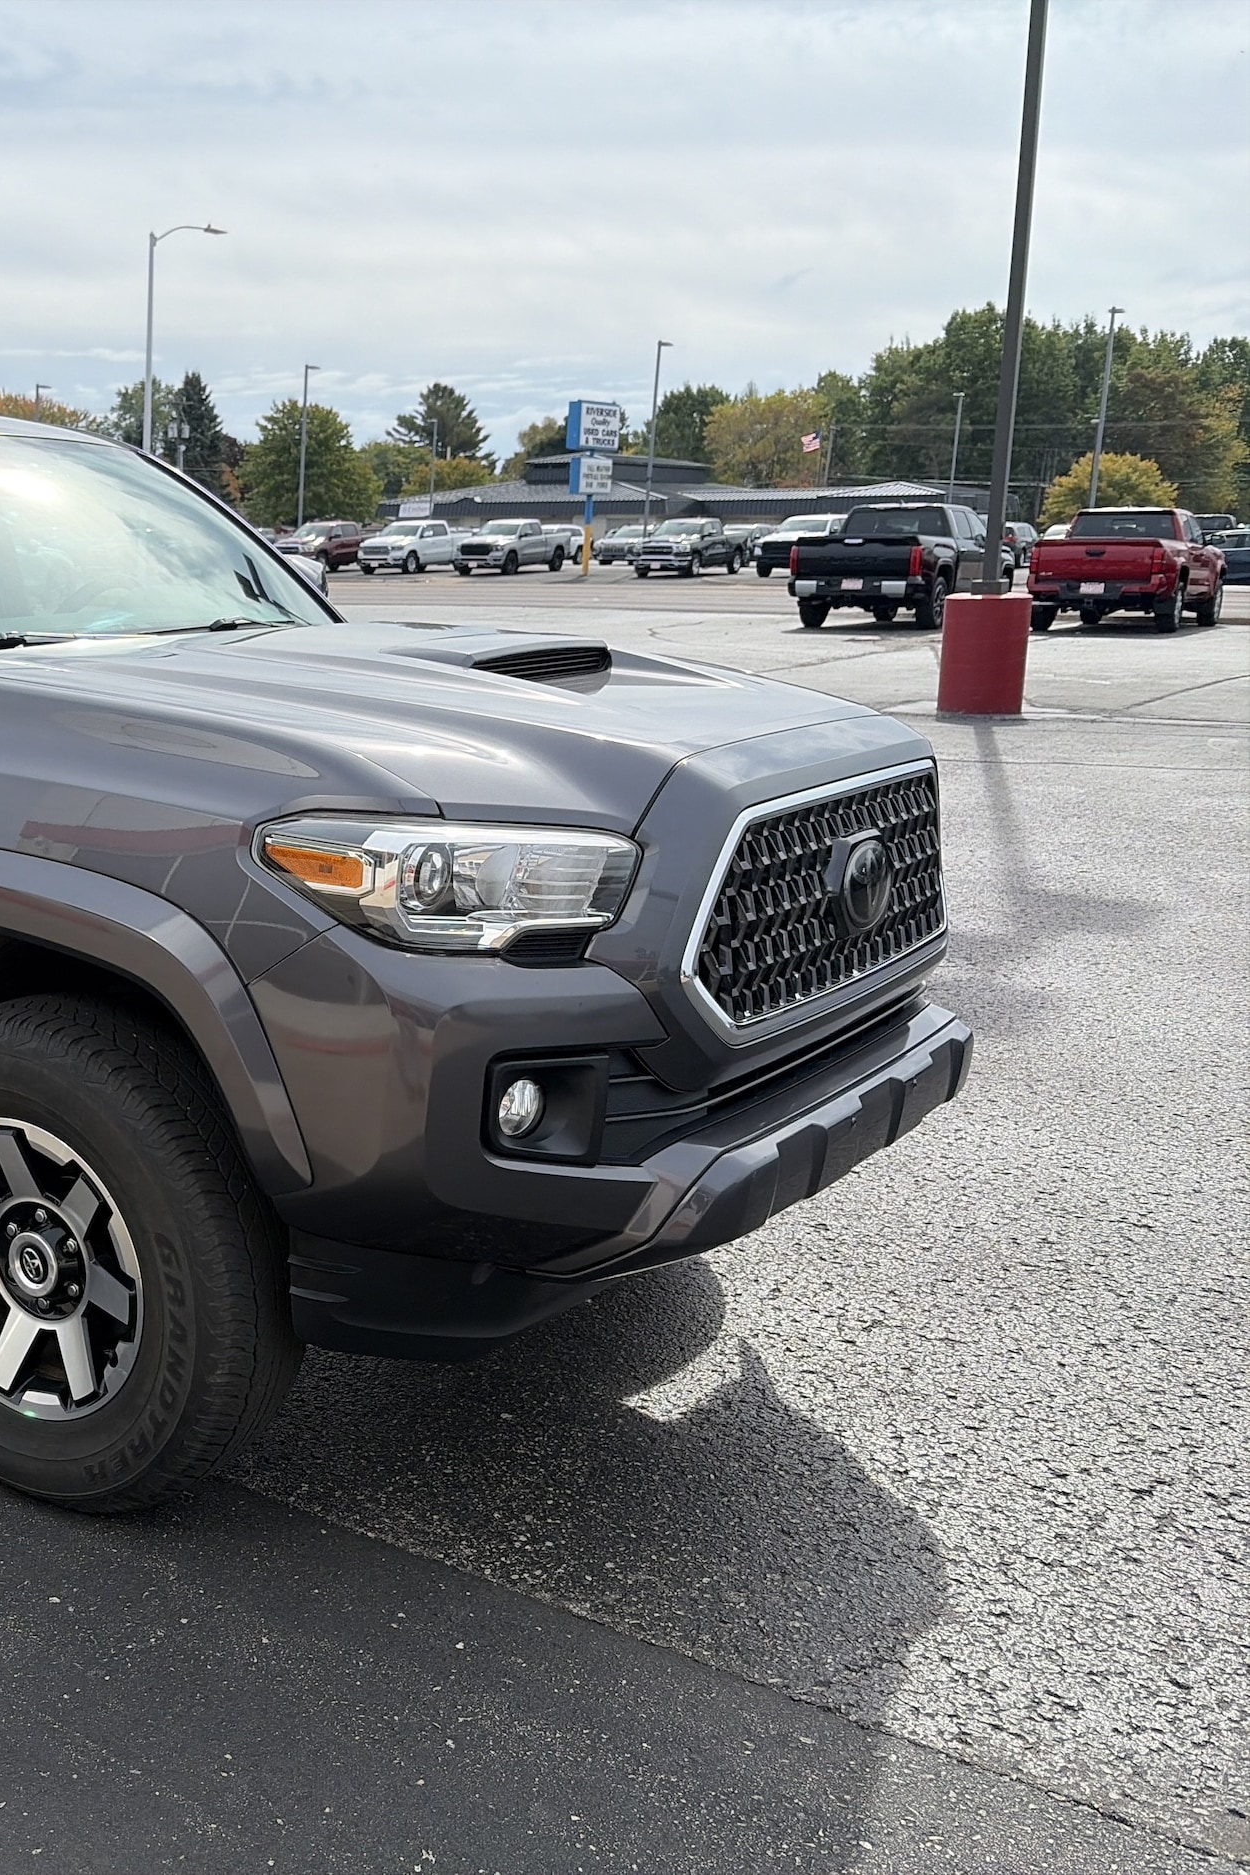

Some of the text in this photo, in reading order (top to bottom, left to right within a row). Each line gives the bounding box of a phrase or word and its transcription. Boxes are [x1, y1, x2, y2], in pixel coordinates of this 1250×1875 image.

[586, 406, 617, 418] RIVERSIDE
[590, 417, 610, 428] Quality
[584, 427, 617, 438] USED CARS
[592, 437, 615, 446] TRUCKS
[82, 1231, 188, 1484] GRANDTREK
